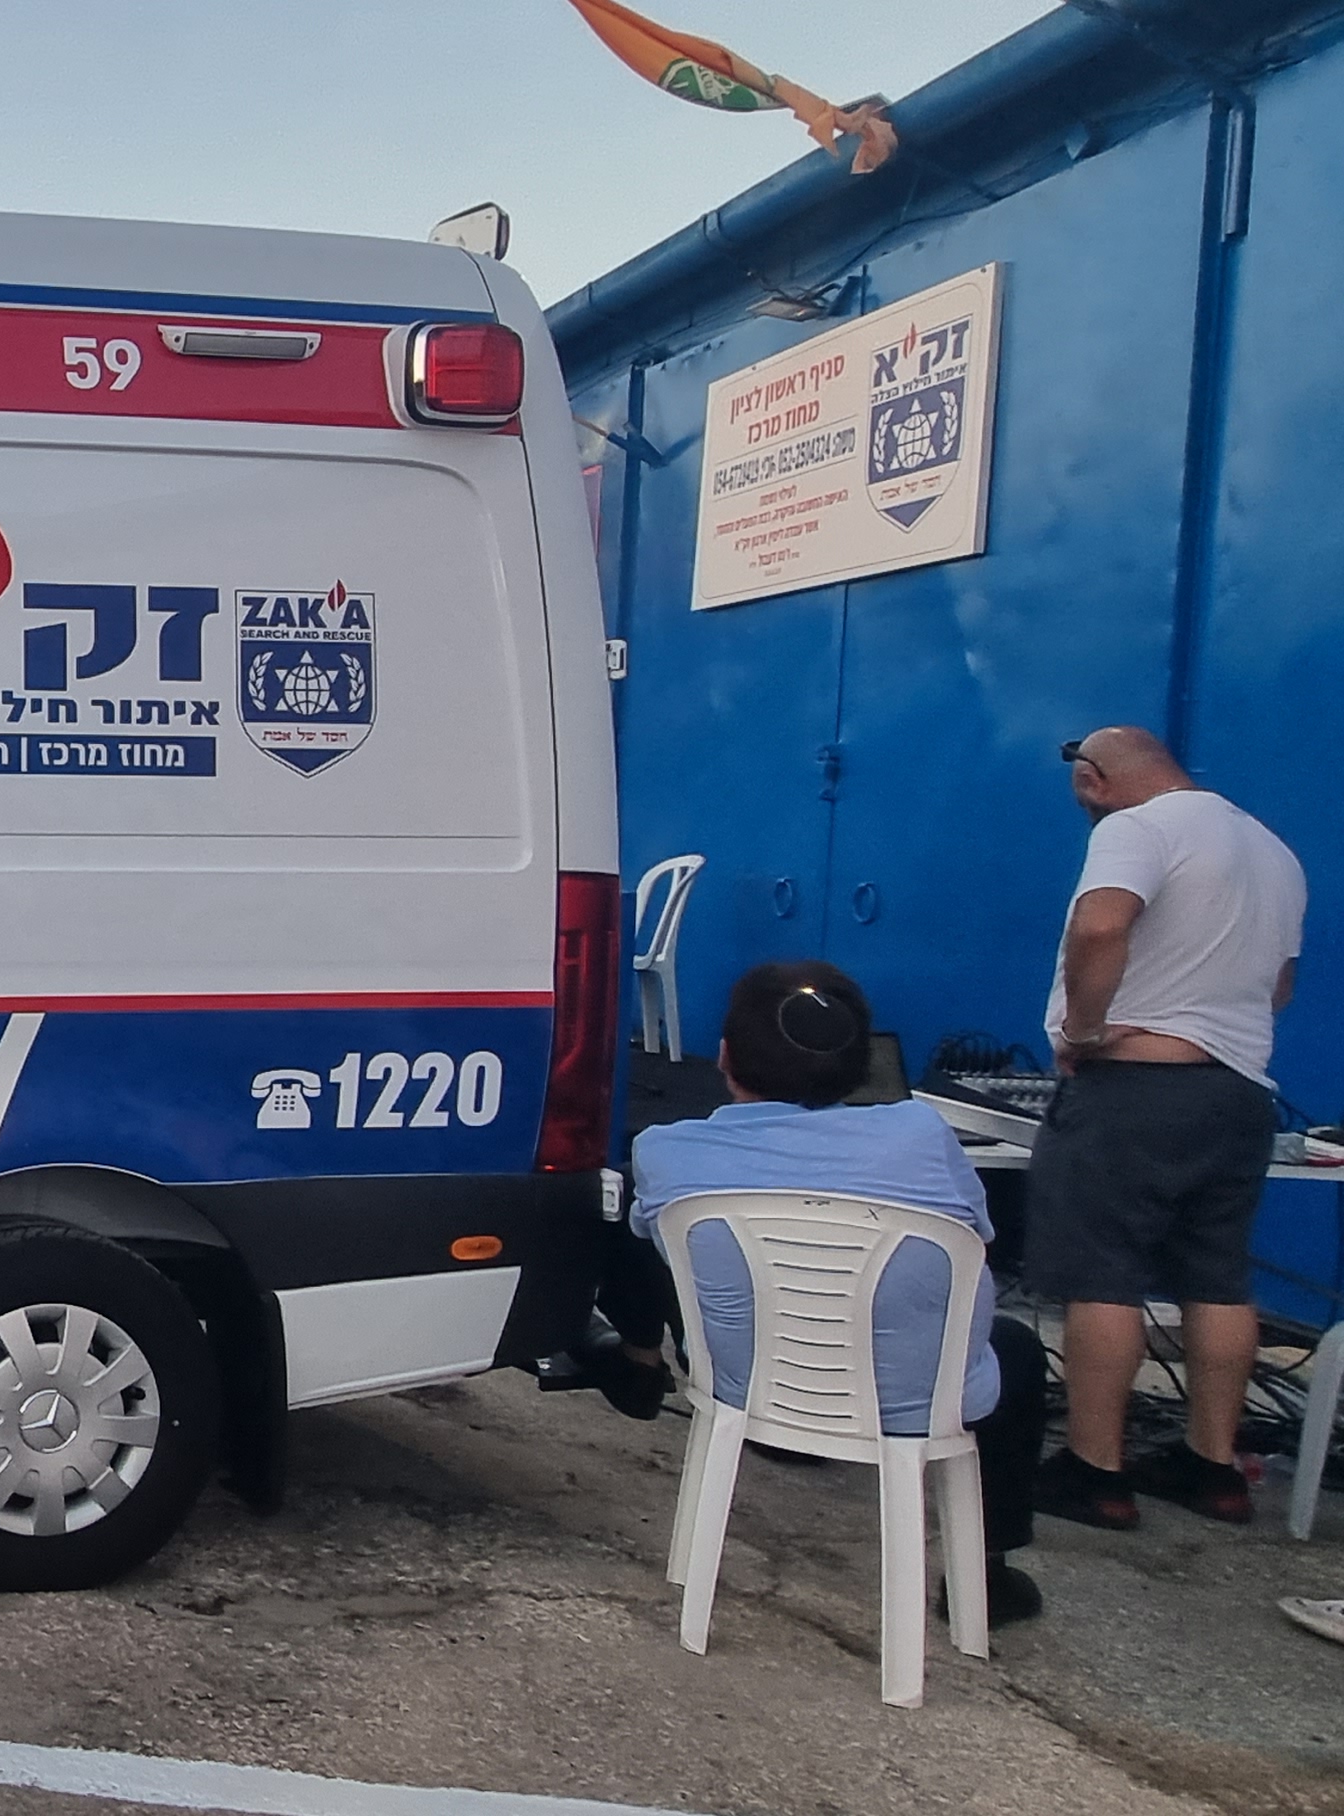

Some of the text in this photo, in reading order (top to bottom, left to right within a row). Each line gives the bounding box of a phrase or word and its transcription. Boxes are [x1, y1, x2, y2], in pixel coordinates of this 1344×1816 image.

[62, 336, 142, 391] 59
[730, 354, 846, 424] סניף ראשון לציון
[870, 385, 900, 404] הצלה
[903, 375, 932, 396] חילוץ
[748, 400, 820, 444] מחוז מרכז
[241, 628, 372, 642] SEARCH AND RESCUE
[90, 696, 220, 726] איתור
[39, 740, 107, 768] מרכז
[116, 741, 186, 768] מחוז
[328, 1050, 503, 1129] 1220
